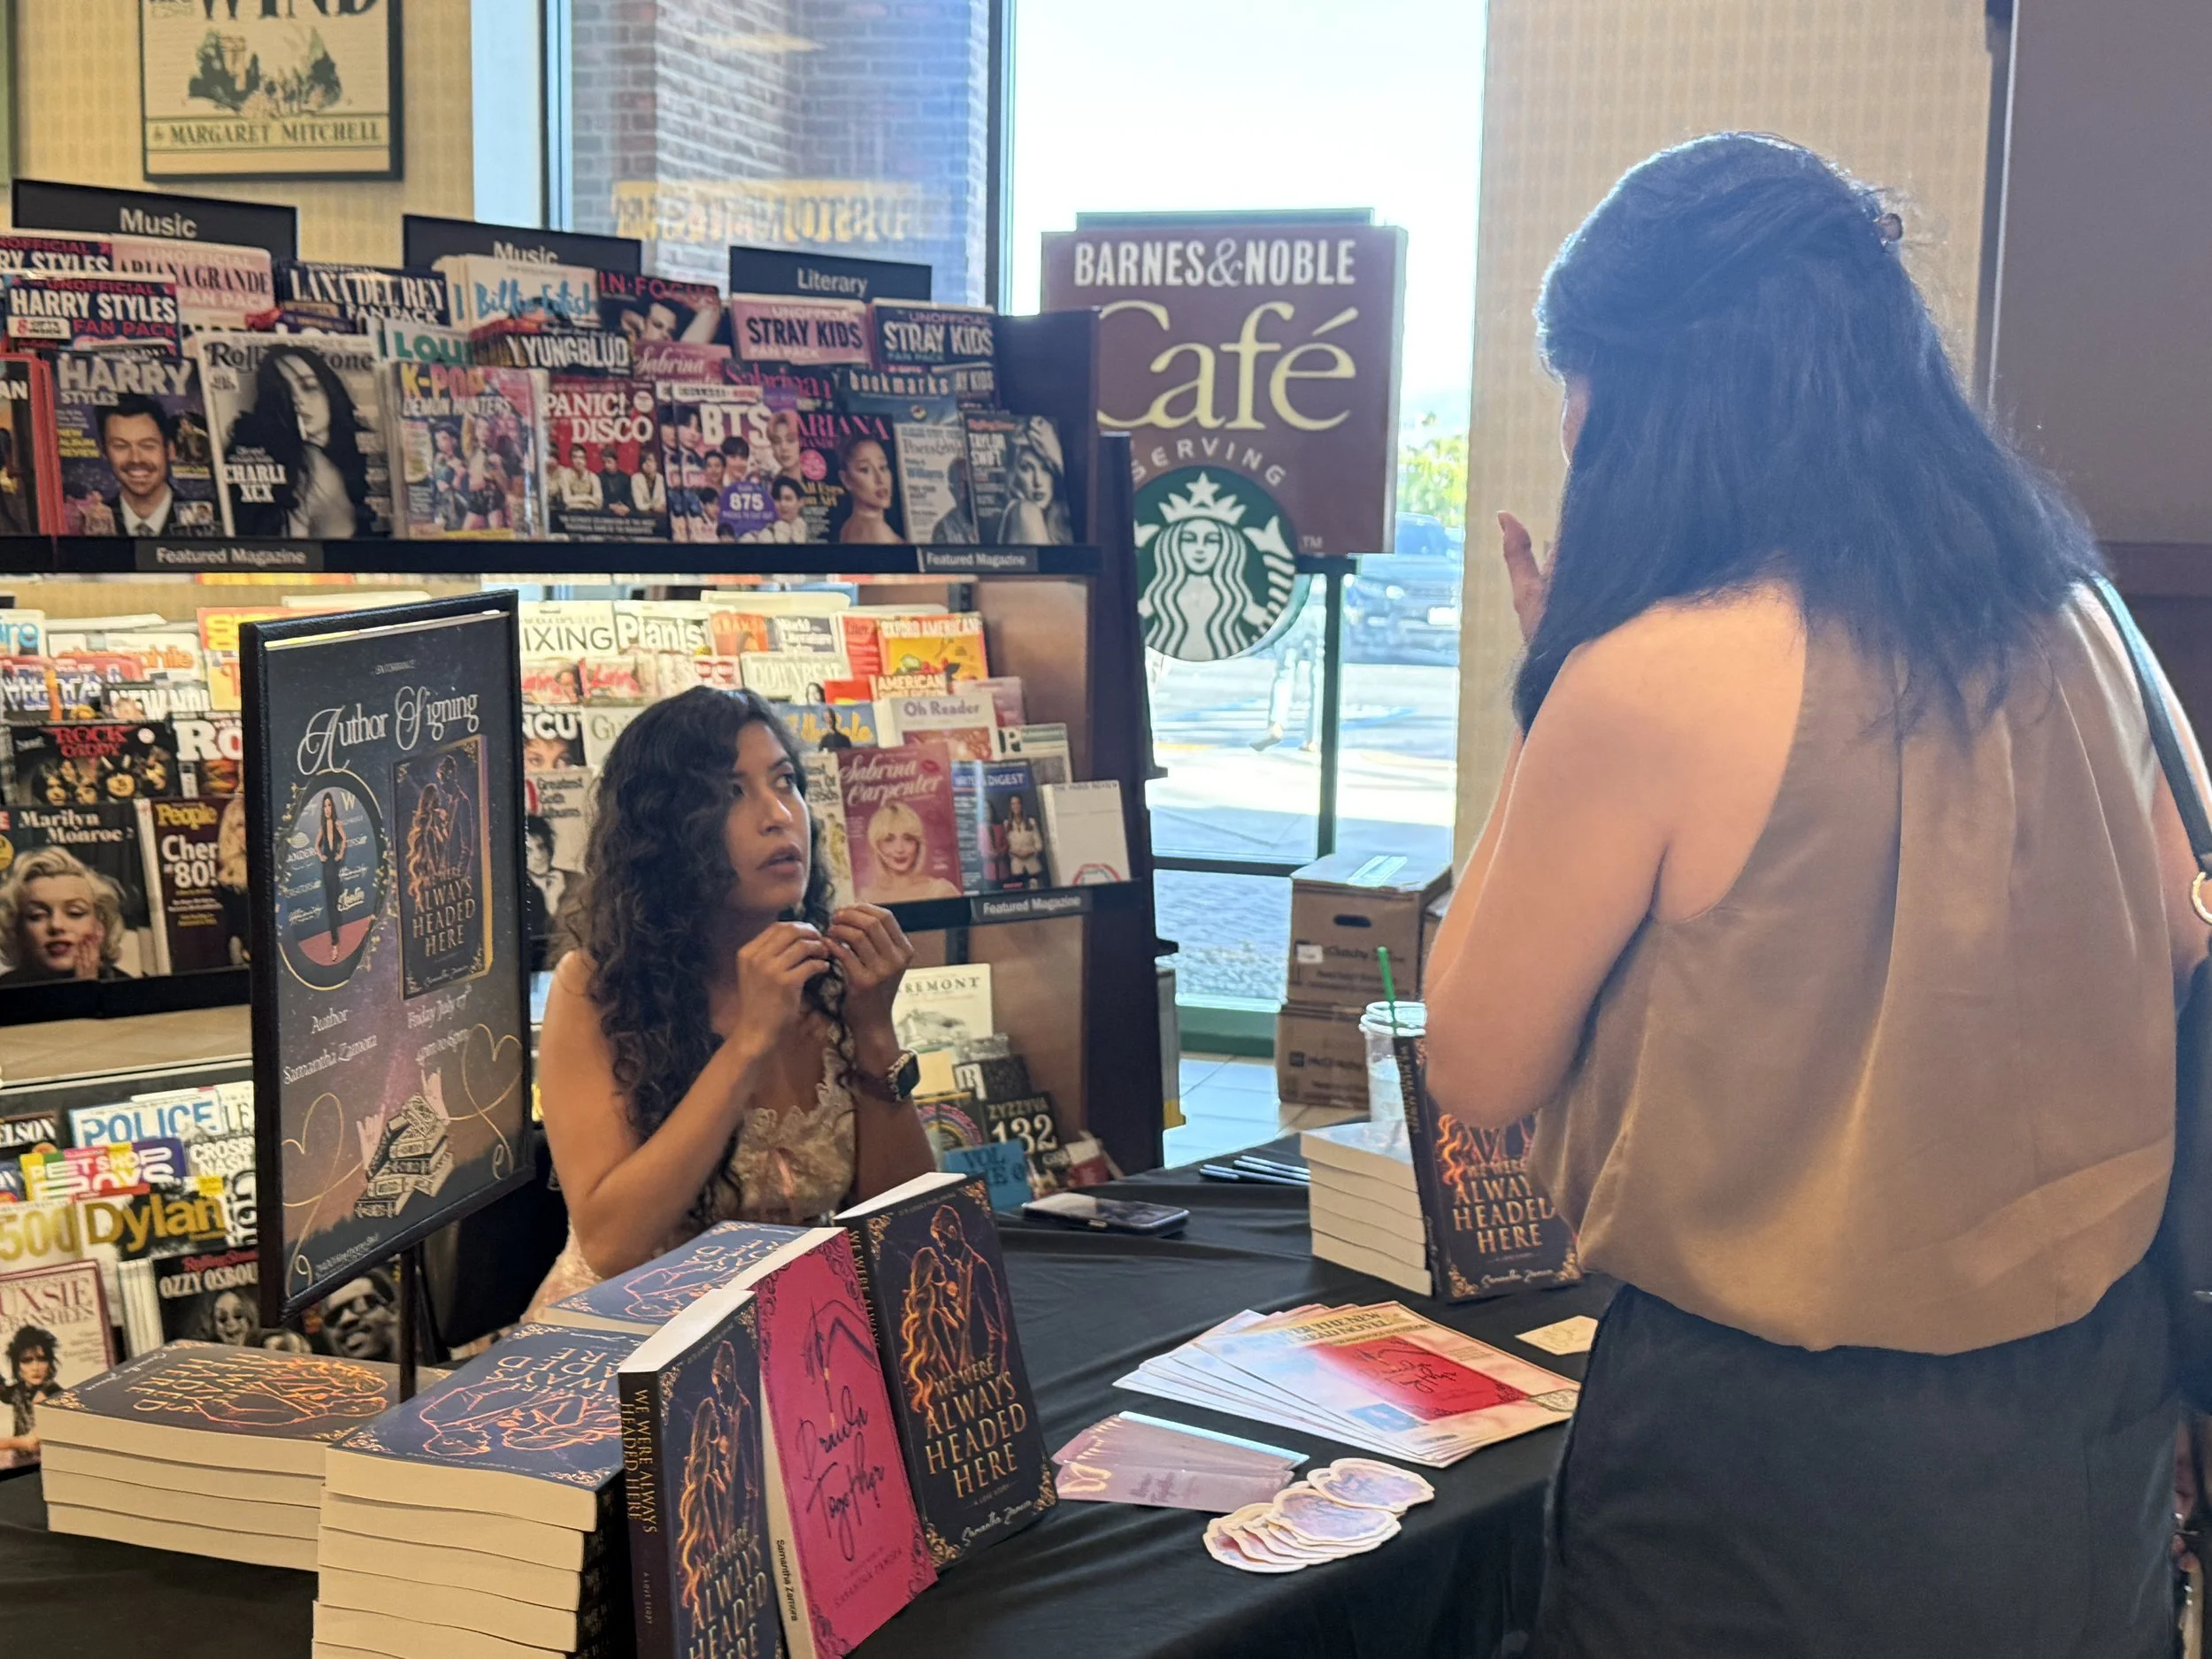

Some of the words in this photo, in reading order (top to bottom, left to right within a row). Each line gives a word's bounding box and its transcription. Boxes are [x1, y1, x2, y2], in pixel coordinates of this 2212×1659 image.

[170, 123, 269, 144] MARGARET
[281, 121, 381, 142] MITCHELL
[119, 206, 198, 239] Music
[31, 250, 112, 273] STYLES
[493, 240, 559, 265] Music
[47, 279, 156, 296] UNOFFICIAL
[194, 268, 272, 295] GRANDE
[402, 276, 445, 310] REY
[796, 267, 868, 294] Literary
[9, 288, 90, 319] HARRY
[97, 292, 177, 325] STYLES
[73, 319, 115, 334] FAN
[121, 321, 176, 337] PACK
[746, 318, 811, 348] STRAY
[817, 319, 864, 349] KIDS
[883, 320, 945, 353] STRAY
[949, 324, 994, 357] KIDS
[393, 331, 475, 365] LOUI
[520, 334, 629, 367] YUNGBLUD
[57, 353, 192, 396] HARRY
[1096, 300, 1360, 432] Café
[60, 390, 119, 406] STYLES
[849, 371, 950, 396] bookmarks
[543, 391, 627, 419] PANIC!
[571, 416, 654, 443] DISCO
[699, 403, 772, 447] BTS
[795, 412, 890, 441] ARIANA
[224, 464, 288, 485] CHARLI
[1131, 436, 1286, 487] SERVING
[240, 484, 275, 503] XCX
[729, 492, 764, 511] 875
[156, 547, 226, 565] Featured
[231, 548, 307, 566] Magazine
[926, 550, 973, 566] Featured
[975, 552, 1026, 569] Magazine
[903, 700, 927, 717] Oh
[930, 700, 980, 717] Reader
[297, 704, 389, 775] Author
[395, 686, 480, 751] Signing
[841, 750, 918, 783] Sabrina
[987, 772, 1025, 787] DIGEST
[848, 773, 942, 810] Carpenter
[18, 809, 101, 831] Marilyn
[155, 802, 219, 831] People
[46, 826, 124, 844] Monroe
[161, 834, 219, 863] Cher
[414, 875, 472, 915] ALWAYS
[982, 901, 1030, 916] Featured
[1032, 895, 1081, 912] Magazine
[412, 898, 476, 939] HEADED
[425, 925, 465, 957] HERE
[904, 976, 981, 995] REMONT
[311, 1008, 351, 1035] Author
[282, 1048, 338, 1086] Samantha
[0, 1118, 57, 1146] ELSON
[81, 1101, 219, 1148] POLICE
[992, 1114, 1058, 1153] 132
[32, 1157, 95, 1180] PET
[96, 1146, 173, 1171] SHOP
[188, 1135, 256, 1164] CROSB
[1454, 1174, 1533, 1207] ALWAY
[84, 1194, 227, 1253] Dylan
[1477, 1223, 1543, 1254] HERE
[159, 1273, 203, 1299] OZZY
[203, 1262, 259, 1290] OSBOU
[1481, 1269, 1523, 1288] Samantha
[1346, 1312, 1380, 1327] NEW
[934, 1374, 957, 1398] WE
[957, 1353, 996, 1386] WERE
[634, 1388, 650, 1414] WE
[926, 1371, 1017, 1440] ALWAYS
[620, 1402, 639, 1473] HEADED
[637, 1419, 653, 1465] WERE
[925, 1402, 1027, 1475] HEADED
[952, 1442, 1018, 1499] HERE
[625, 1478, 643, 1521] HERE
[639, 1470, 659, 1535] ALWAYS
[961, 1510, 1002, 1547] Samantha
[776, 1539, 793, 1589] Samantha
[692, 1532, 763, 1639] ALWAYS
